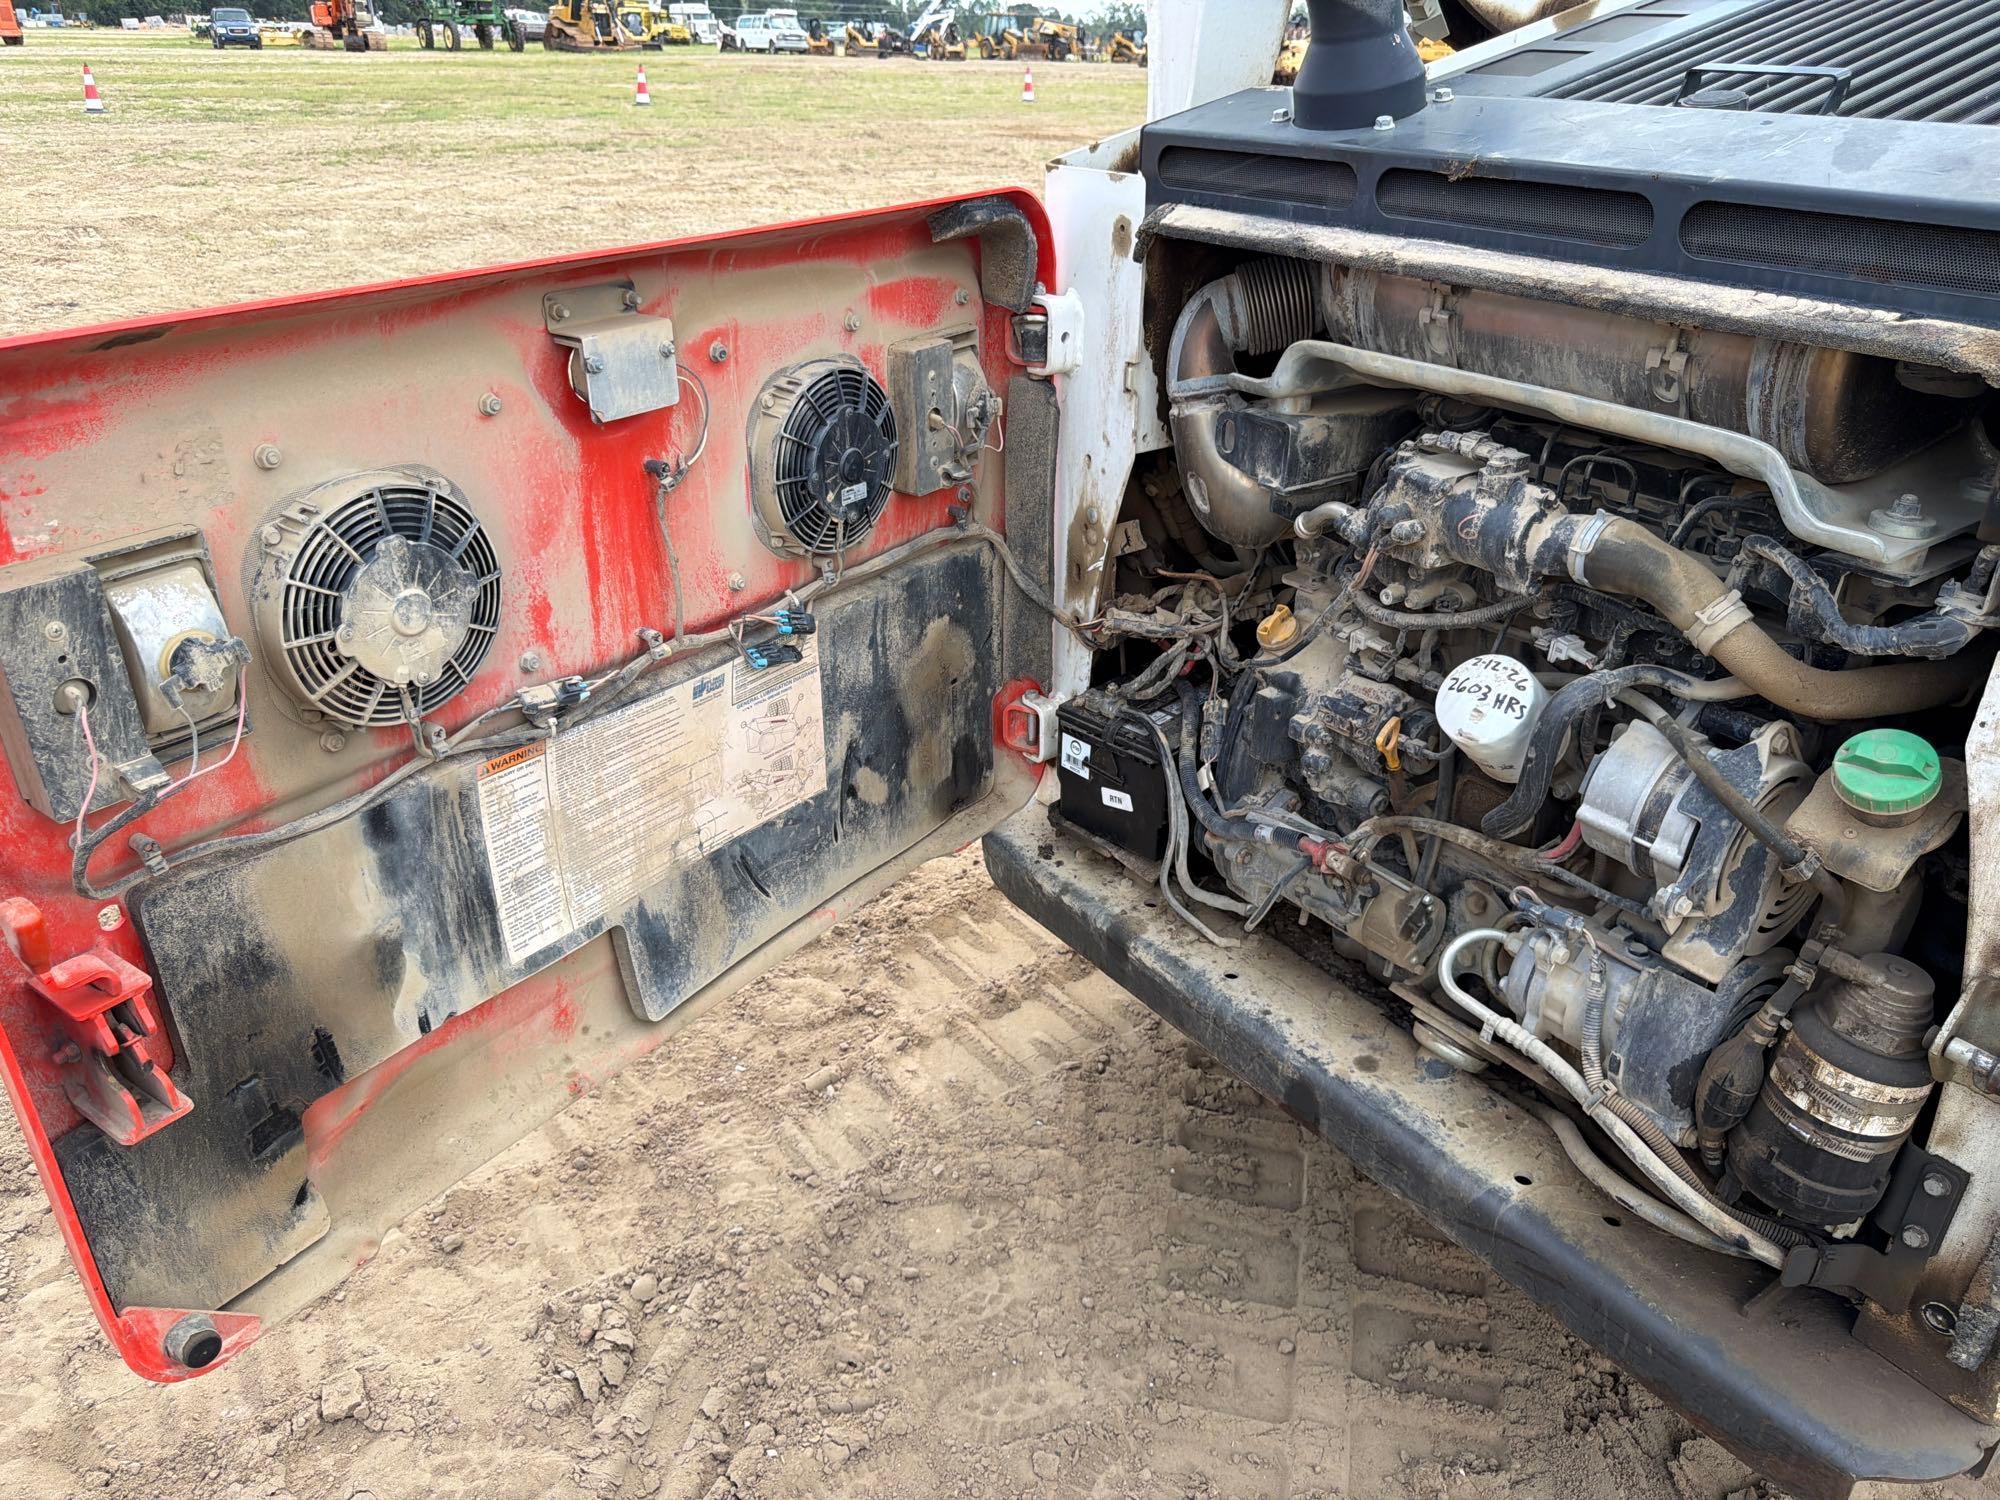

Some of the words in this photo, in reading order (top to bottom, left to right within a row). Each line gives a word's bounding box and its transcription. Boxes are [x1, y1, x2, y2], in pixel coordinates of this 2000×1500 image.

[1472, 658, 1528, 691] 2-12-26
[1448, 678, 1492, 701] 2603
[1492, 693, 1527, 719] HRS
[491, 745, 543, 770] WARNING
[1109, 795, 1123, 805] RTN
